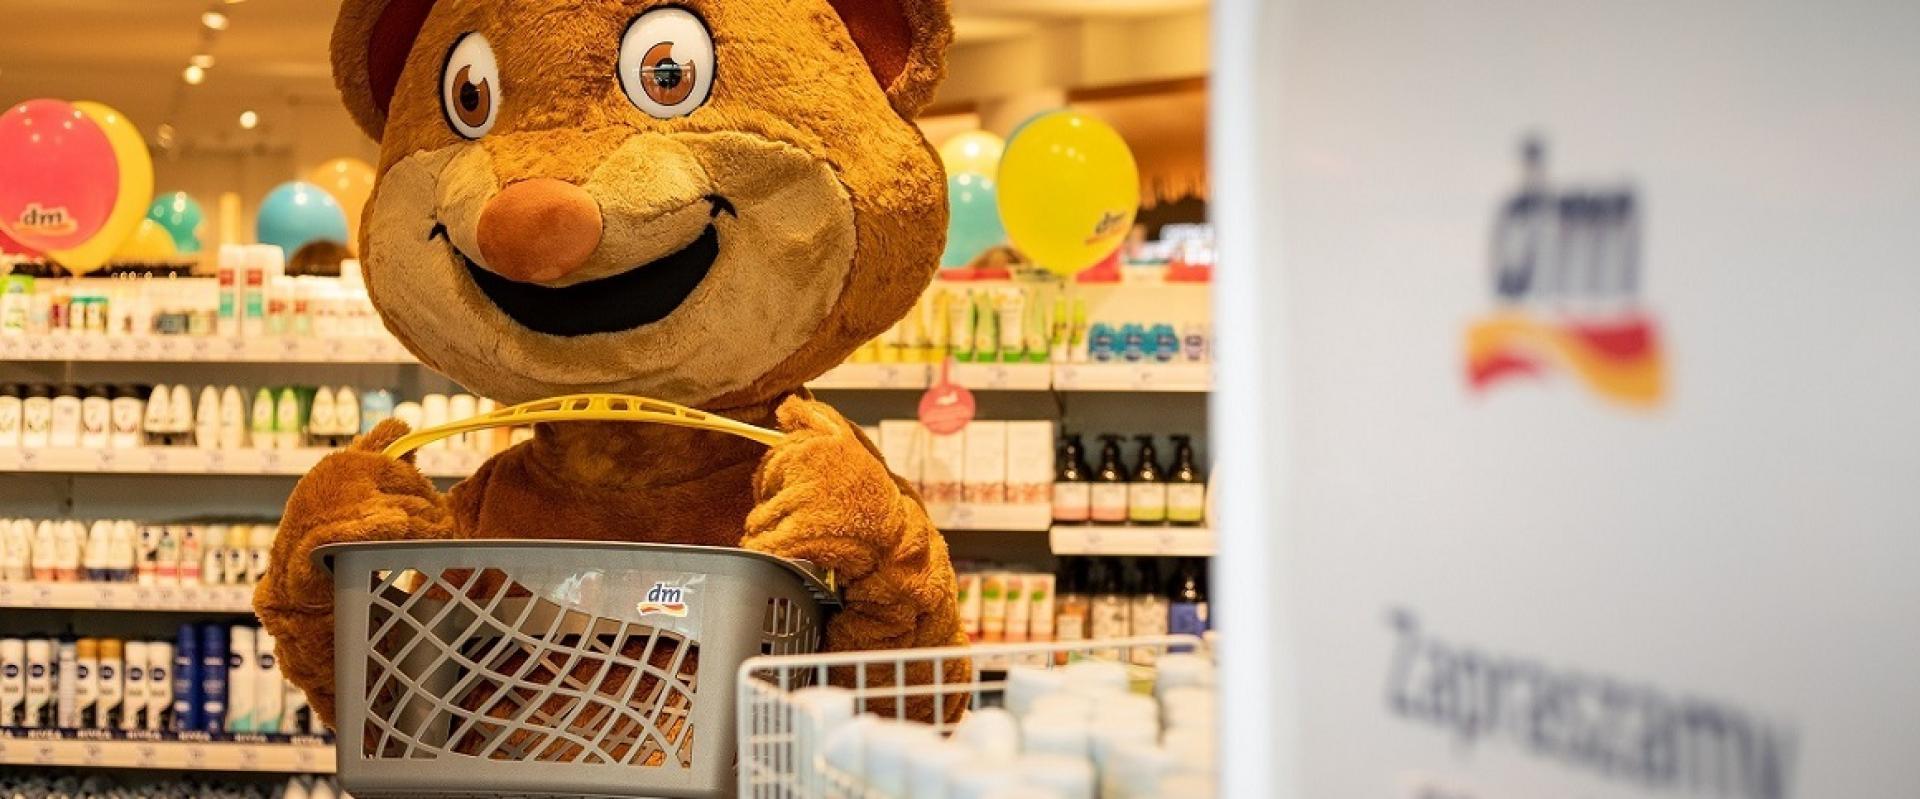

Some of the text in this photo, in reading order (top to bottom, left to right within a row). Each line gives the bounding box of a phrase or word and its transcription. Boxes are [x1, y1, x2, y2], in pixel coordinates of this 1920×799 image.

[24, 207, 63, 226] dm
[1488, 138, 1642, 302] dm
[648, 583, 681, 603] dm
[1386, 606, 1799, 799] Zapraszamy
